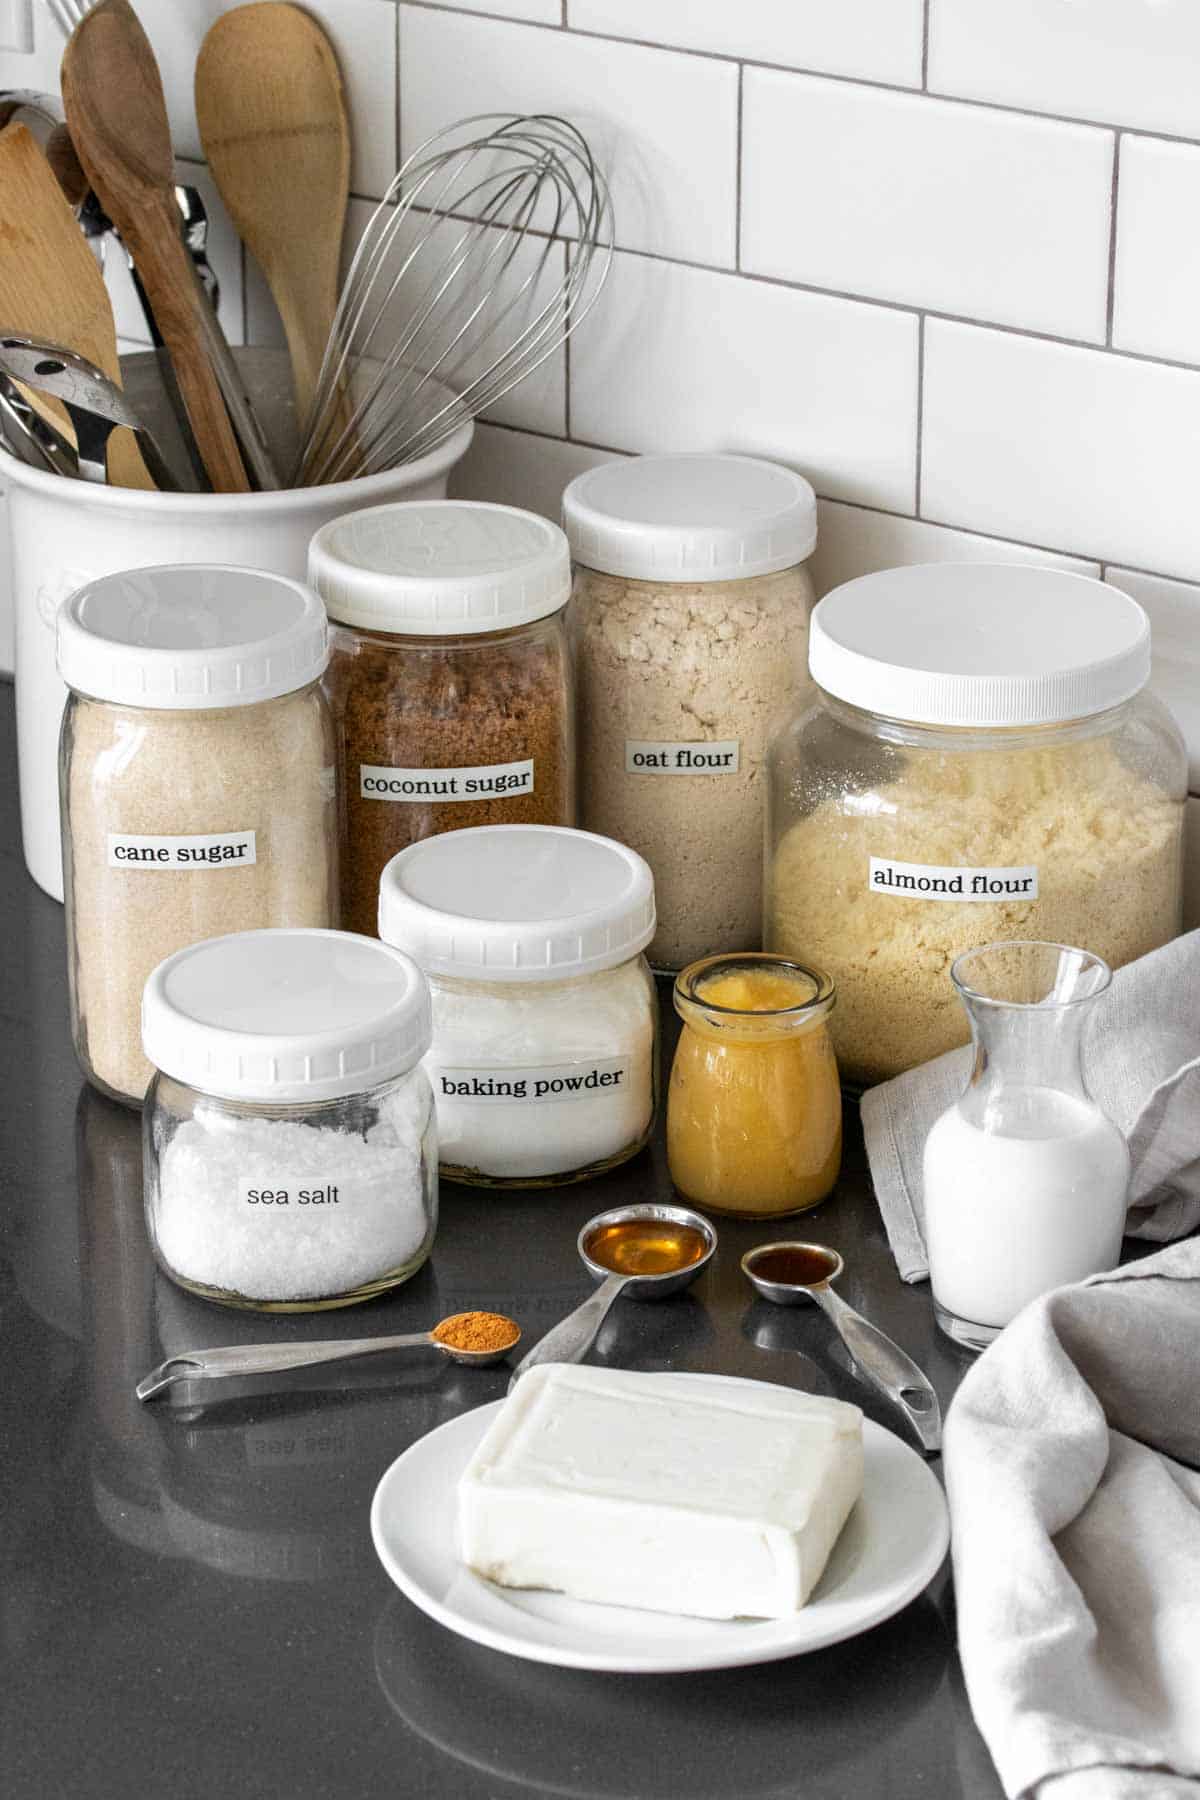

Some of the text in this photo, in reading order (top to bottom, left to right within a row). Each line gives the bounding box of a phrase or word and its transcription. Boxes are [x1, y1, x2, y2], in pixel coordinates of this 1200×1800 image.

[633, 750, 734, 768] oat flour
[363, 772, 531, 795] coconut sugar
[114, 843, 248, 863] cane sugar
[874, 868, 1033, 894] almond flour
[440, 1070, 624, 1098] baking powder
[247, 1185, 340, 1205] sea salt
